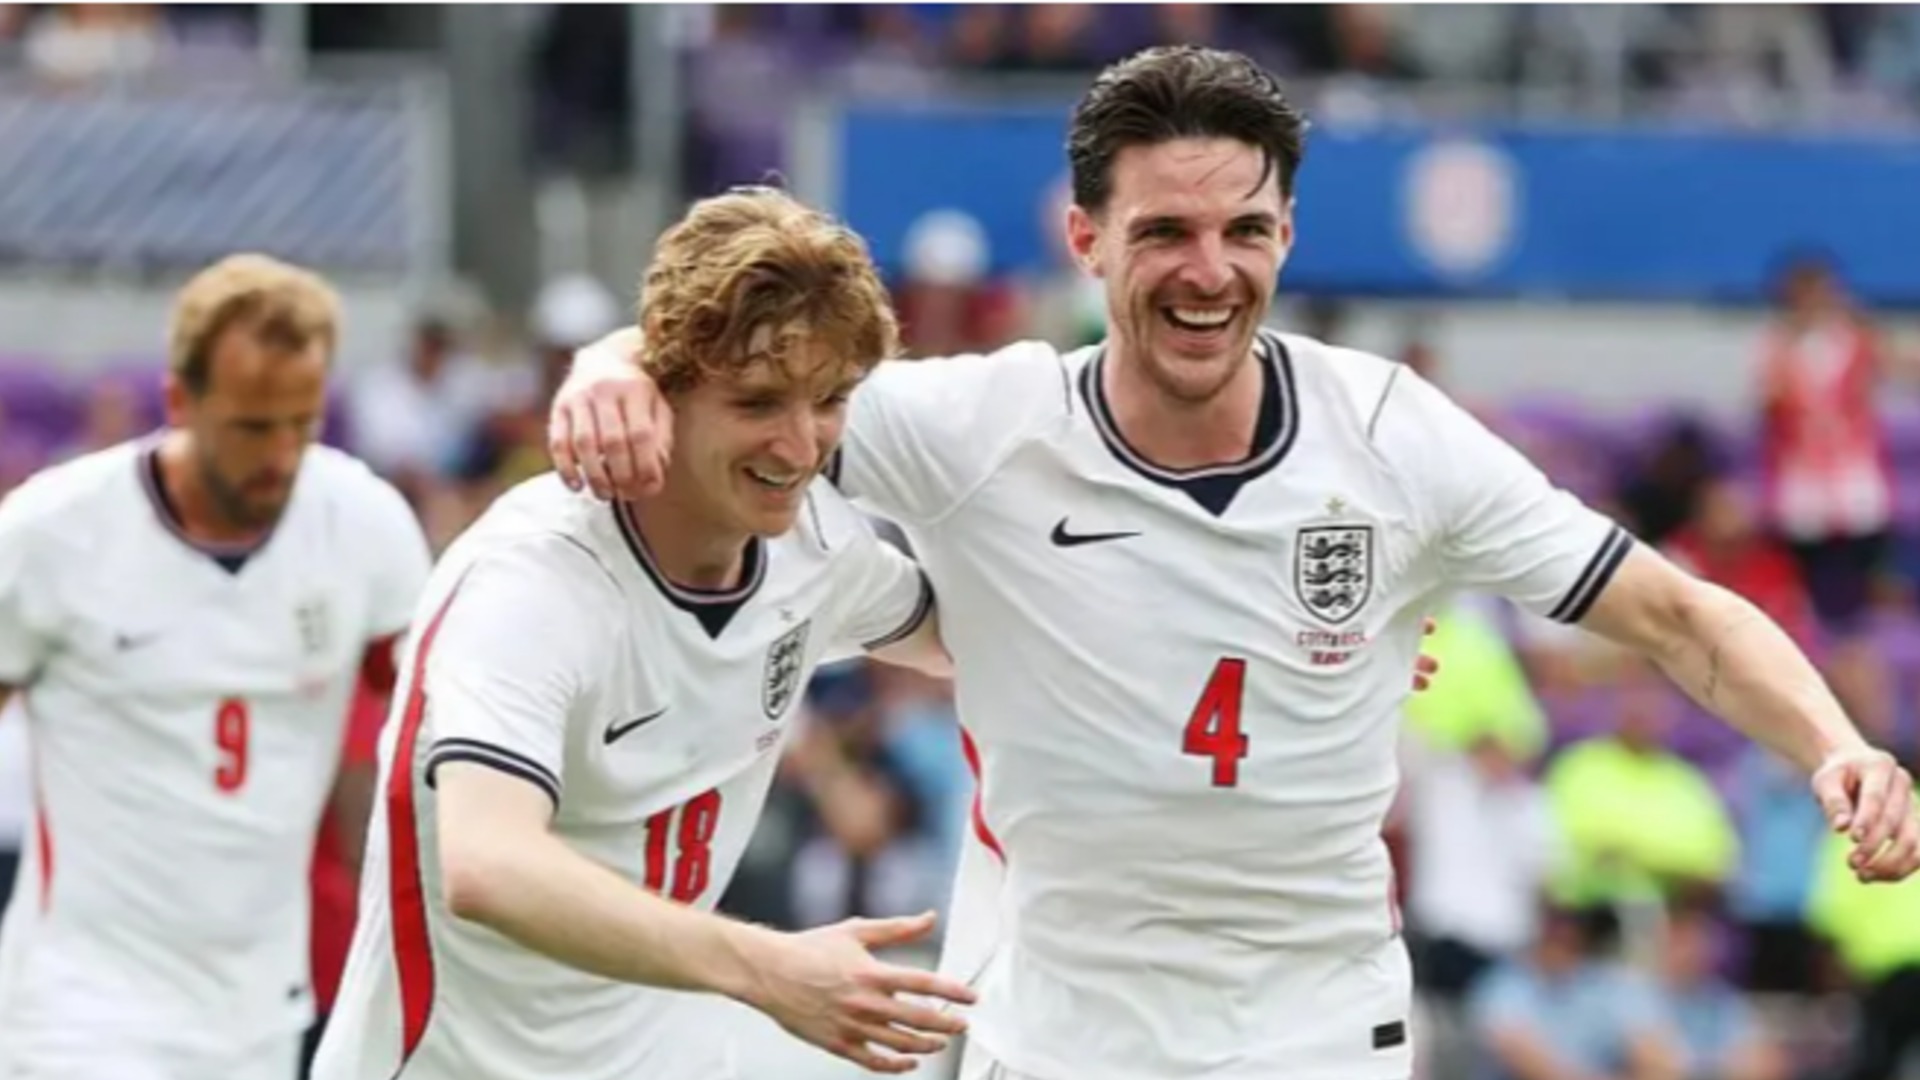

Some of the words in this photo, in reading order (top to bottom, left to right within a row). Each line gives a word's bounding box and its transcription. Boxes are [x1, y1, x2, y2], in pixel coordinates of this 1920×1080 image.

[213, 697, 251, 794] 9
[1181, 657, 1249, 787] 4
[644, 787, 722, 906] 18
